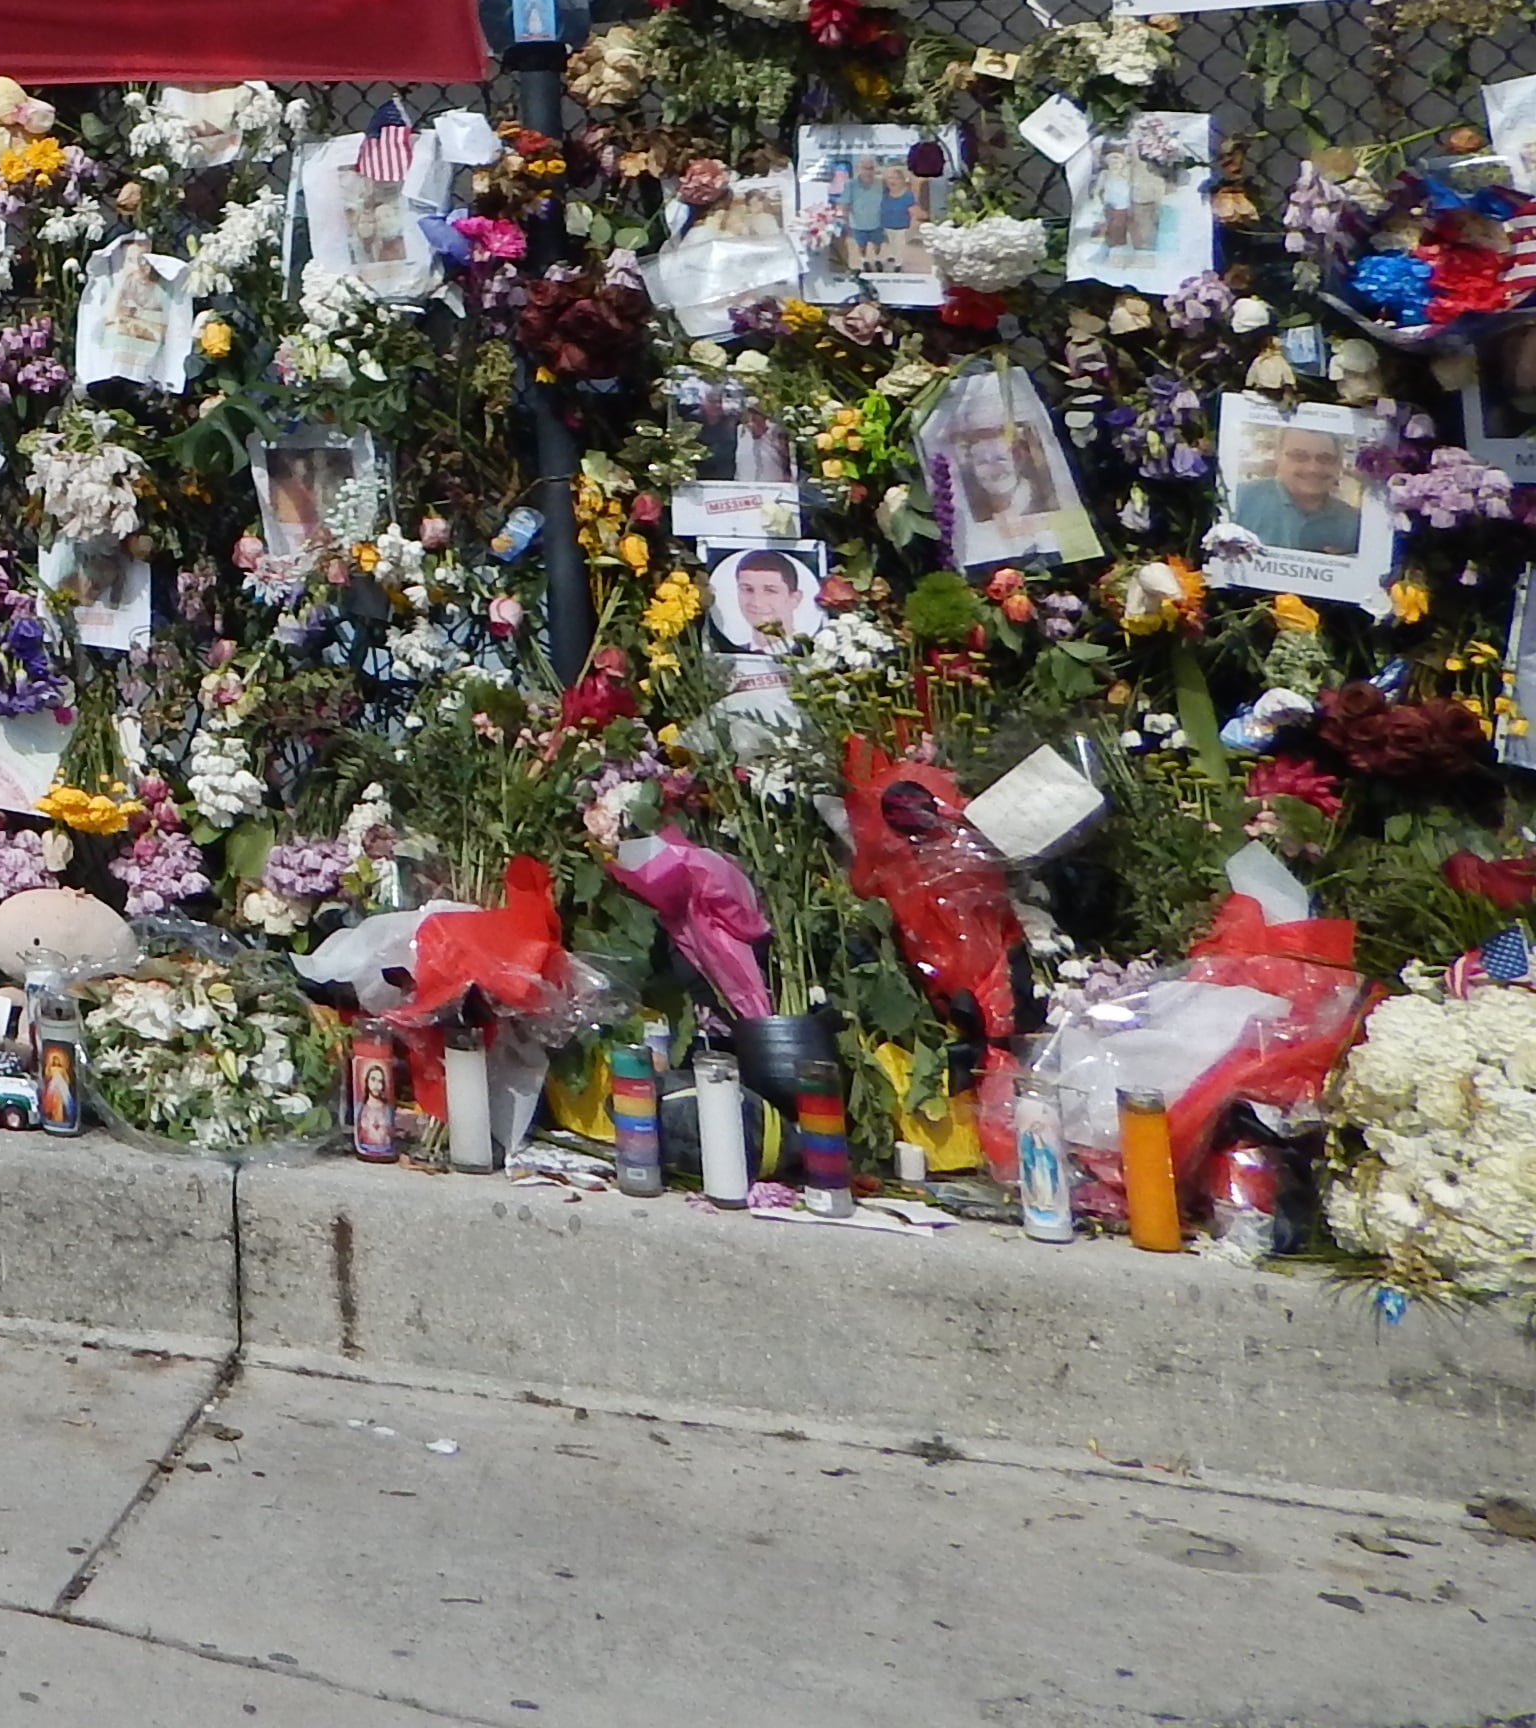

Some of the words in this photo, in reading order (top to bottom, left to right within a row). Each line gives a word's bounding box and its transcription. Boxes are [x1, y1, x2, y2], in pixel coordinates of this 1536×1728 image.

[708, 497, 761, 511] MISSING
[1254, 559, 1334, 582] MISSING
[737, 672, 788, 689] MISSIN
